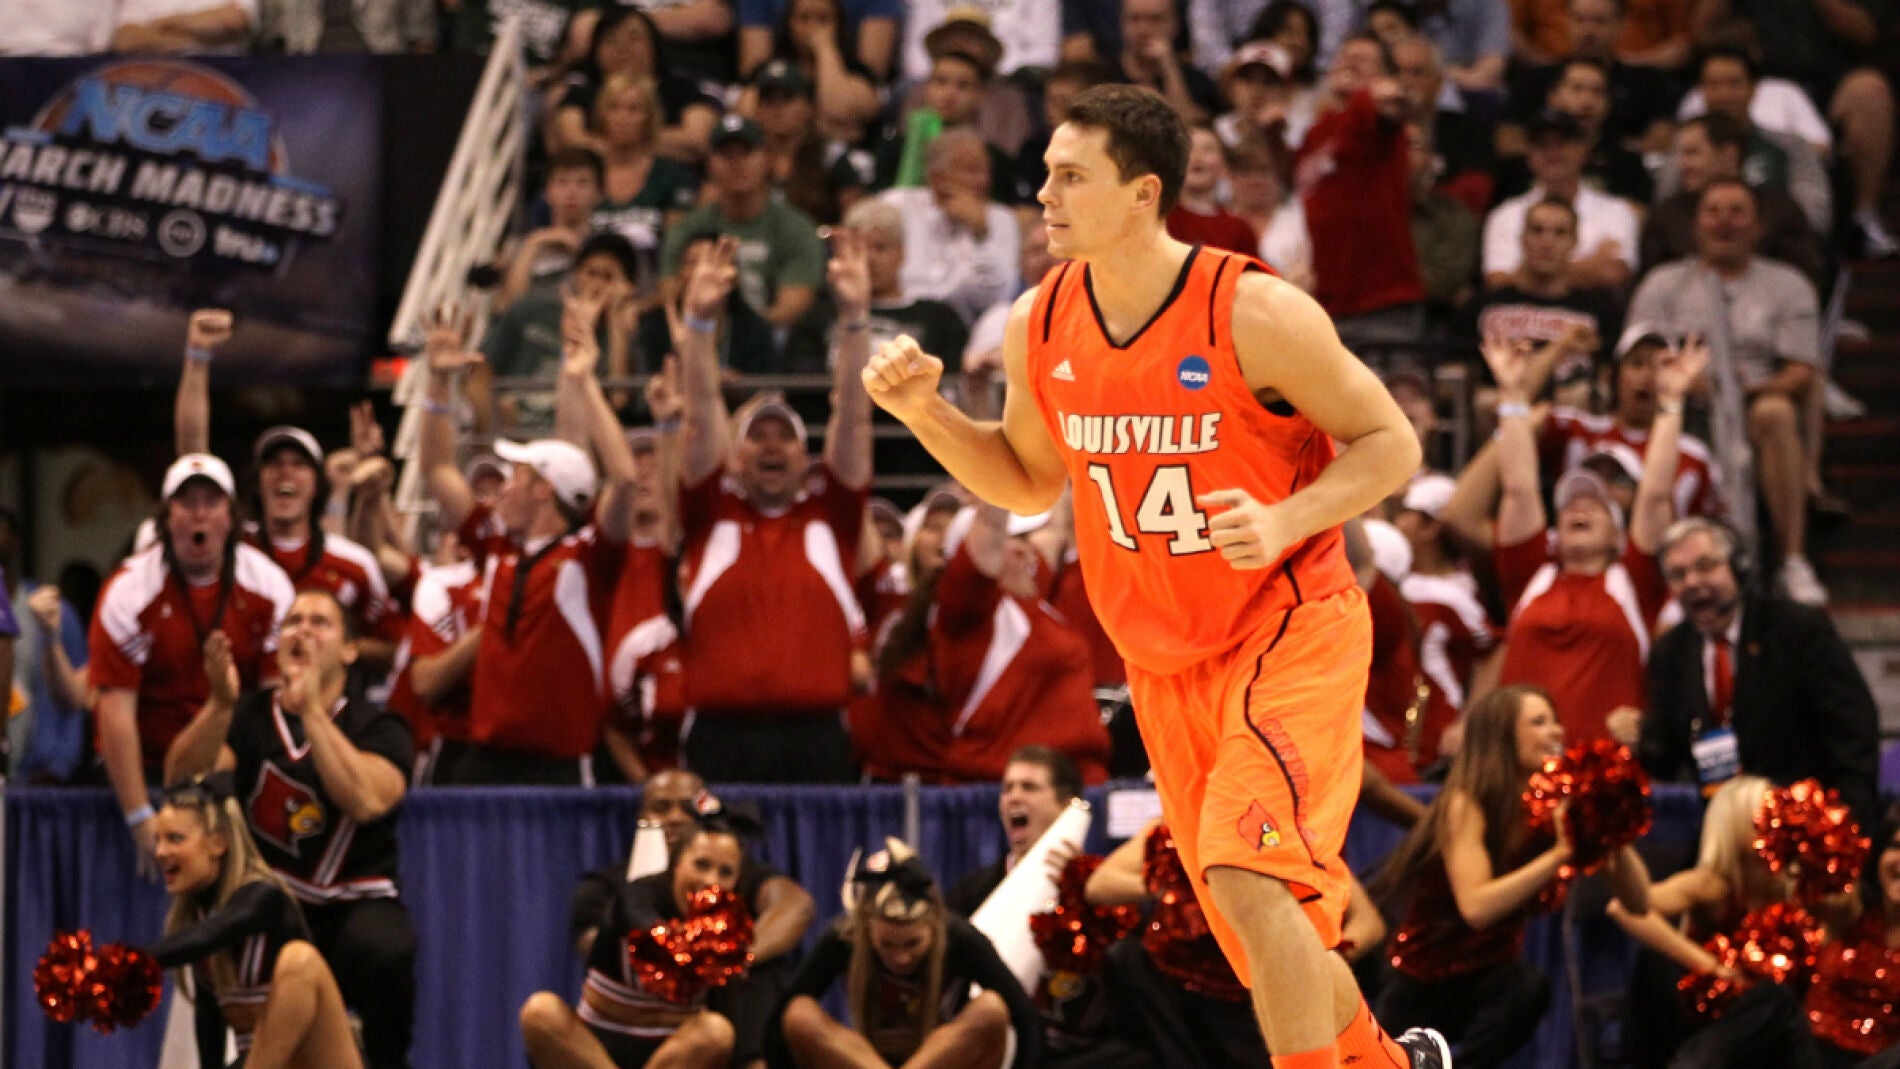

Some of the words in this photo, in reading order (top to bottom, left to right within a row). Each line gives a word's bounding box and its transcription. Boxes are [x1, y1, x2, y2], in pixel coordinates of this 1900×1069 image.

[61, 77, 270, 172] NCAA
[0, 138, 128, 195] ARCH
[131, 160, 336, 237] MADNESS
[1057, 410, 1223, 454] LOUISVILLE
[1087, 461, 1217, 556] 14
